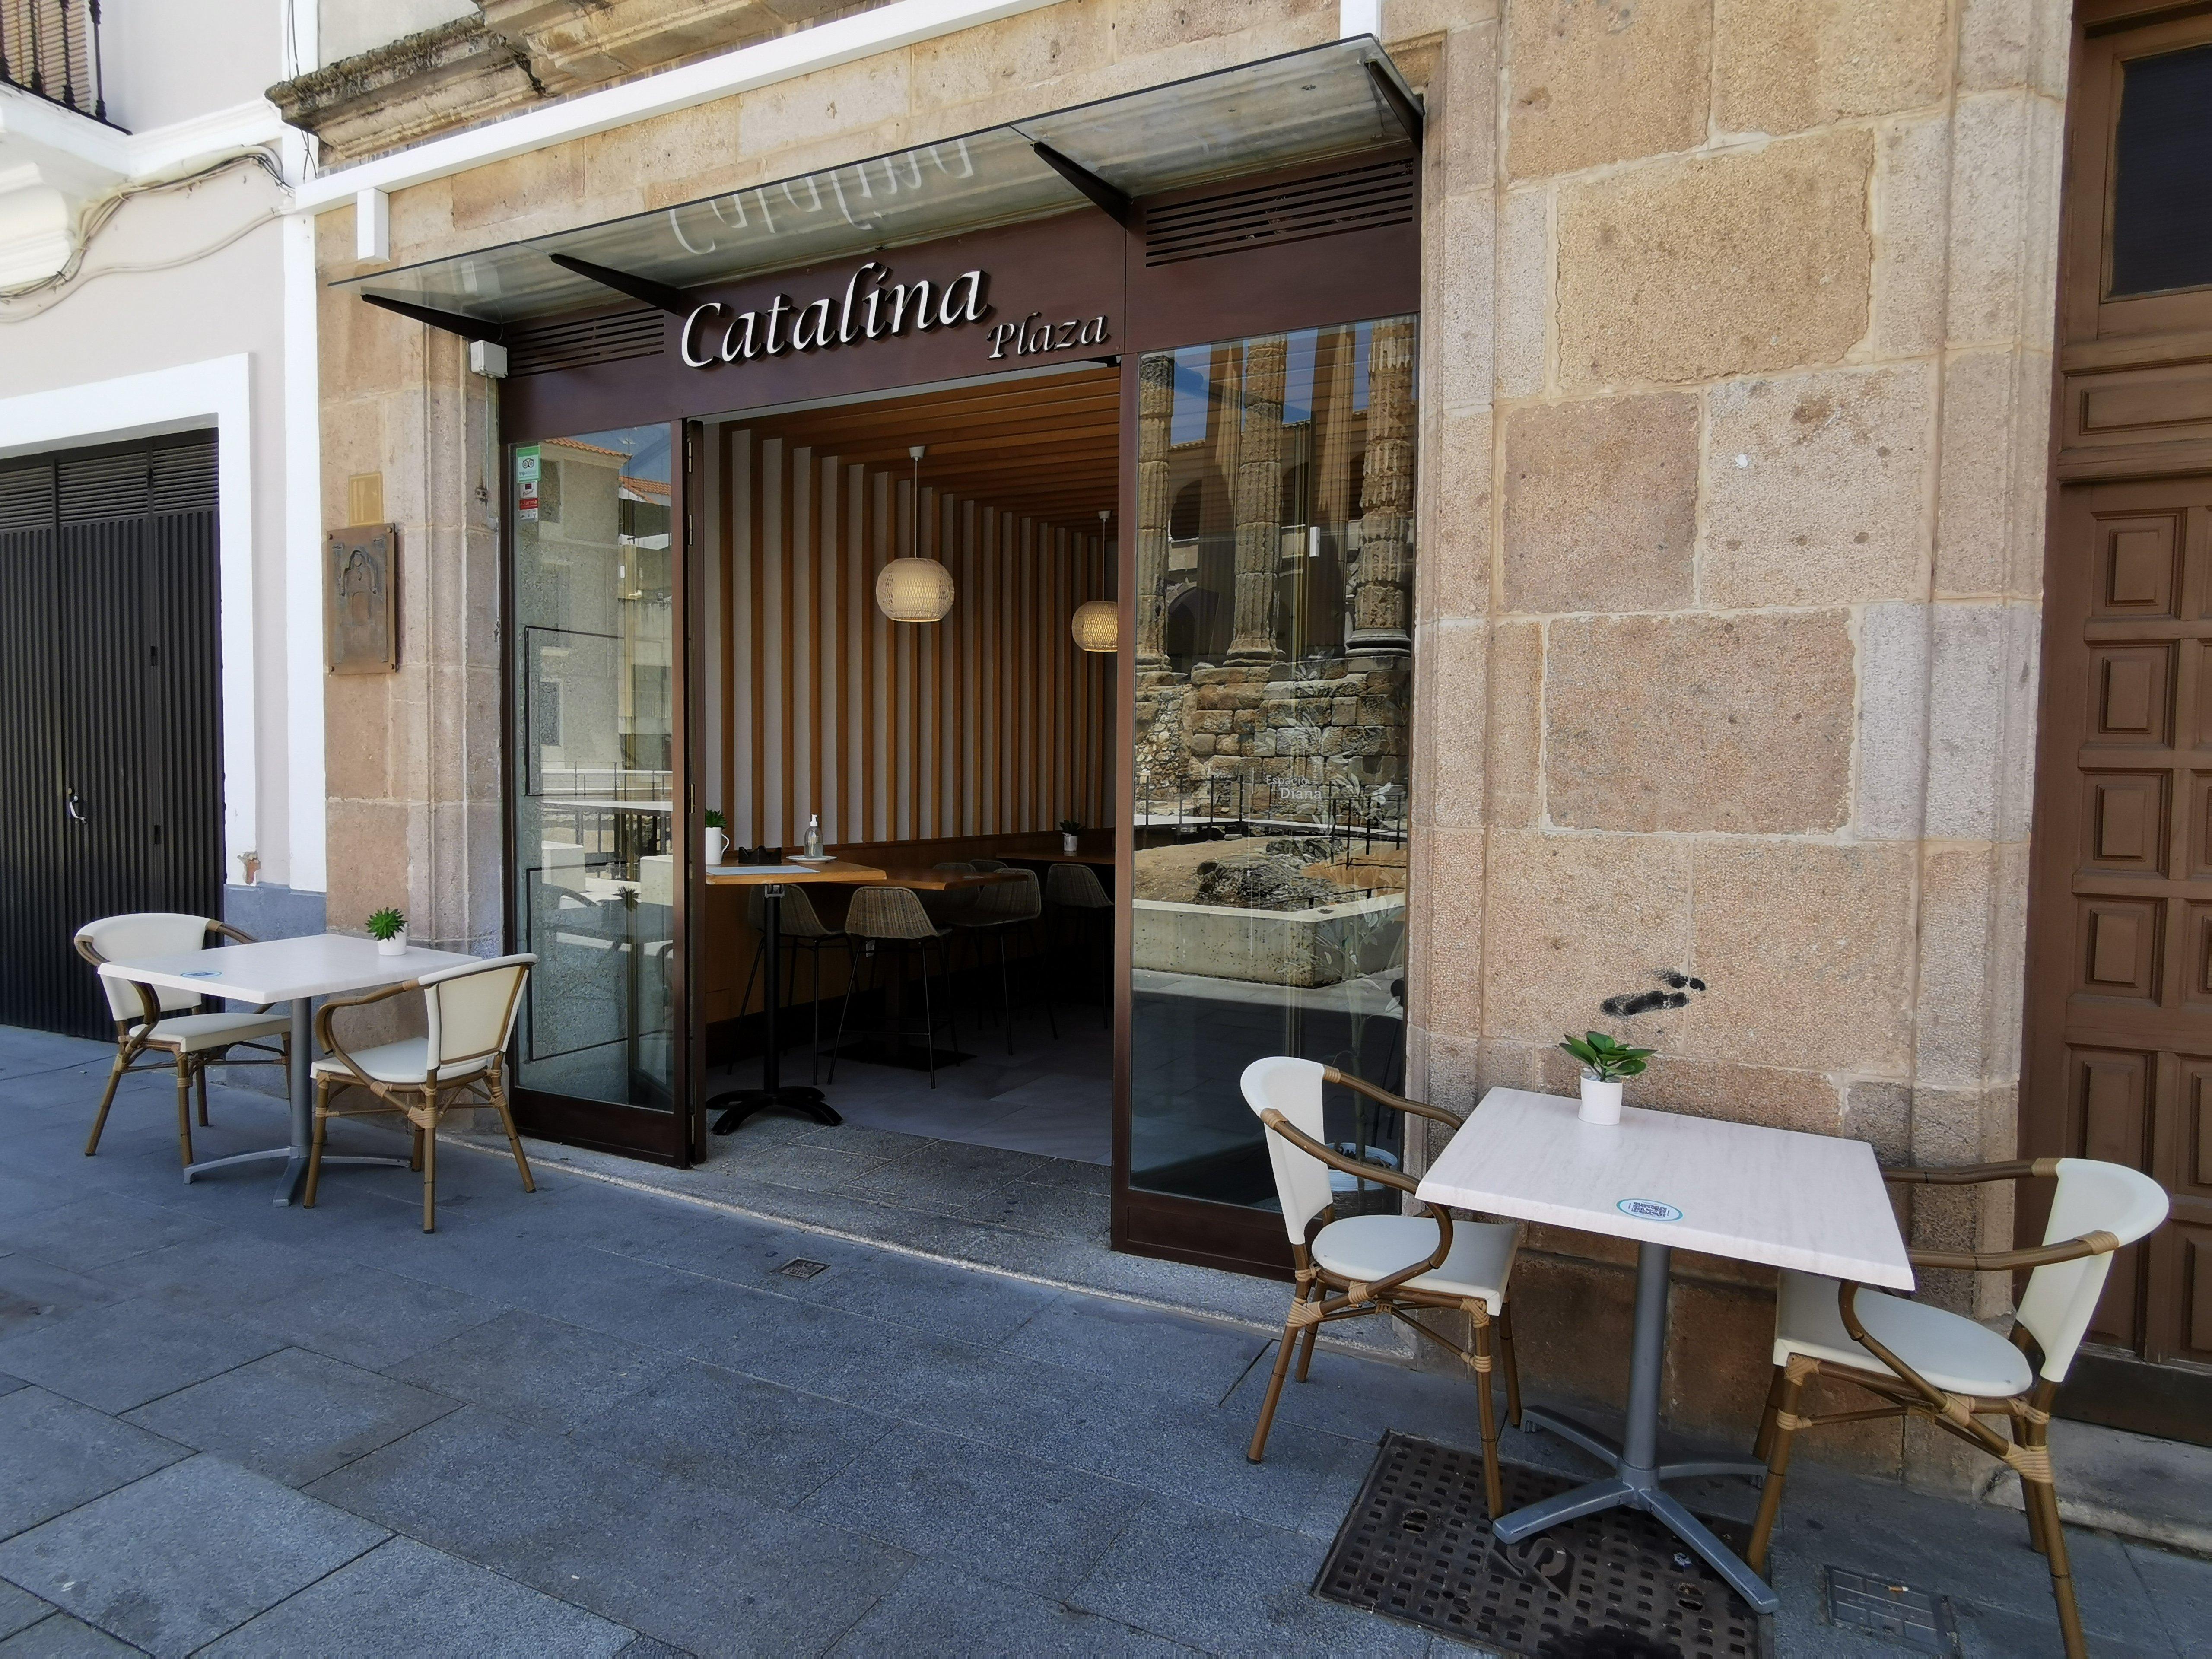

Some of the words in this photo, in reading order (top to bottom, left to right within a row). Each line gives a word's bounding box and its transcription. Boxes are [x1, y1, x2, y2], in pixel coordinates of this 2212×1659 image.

[680, 261, 993, 369] Catalina
[986, 311, 1109, 360] Plaza
[1266, 775, 1308, 787] Espacio
[1280, 787, 1322, 799] Diana
